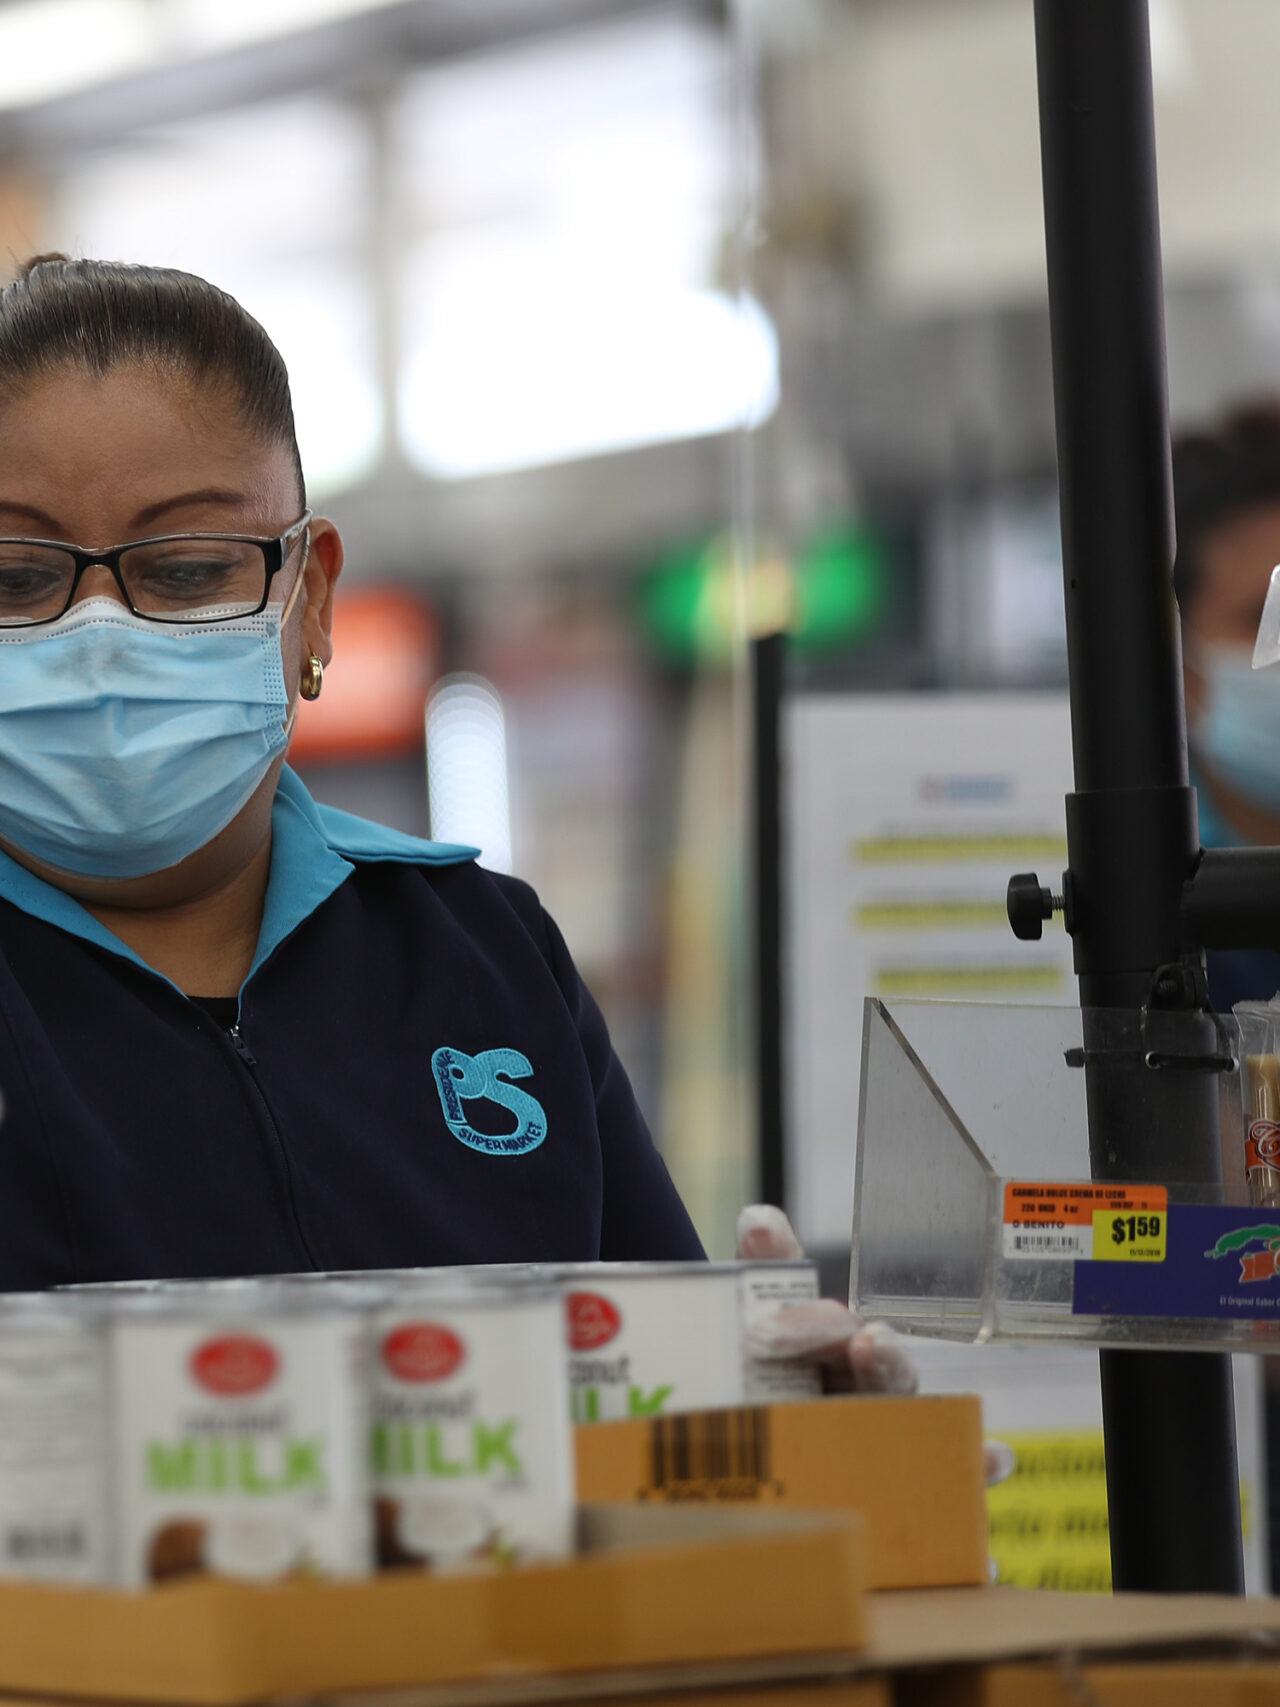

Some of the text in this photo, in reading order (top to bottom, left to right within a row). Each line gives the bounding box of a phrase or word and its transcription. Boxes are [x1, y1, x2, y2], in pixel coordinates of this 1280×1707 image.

[458, 1121, 544, 1151] SUPERMARKET
[1023, 1219, 1065, 1230] BENITO
[1111, 1216, 1160, 1246] $159
[145, 1437, 328, 1494] MILK
